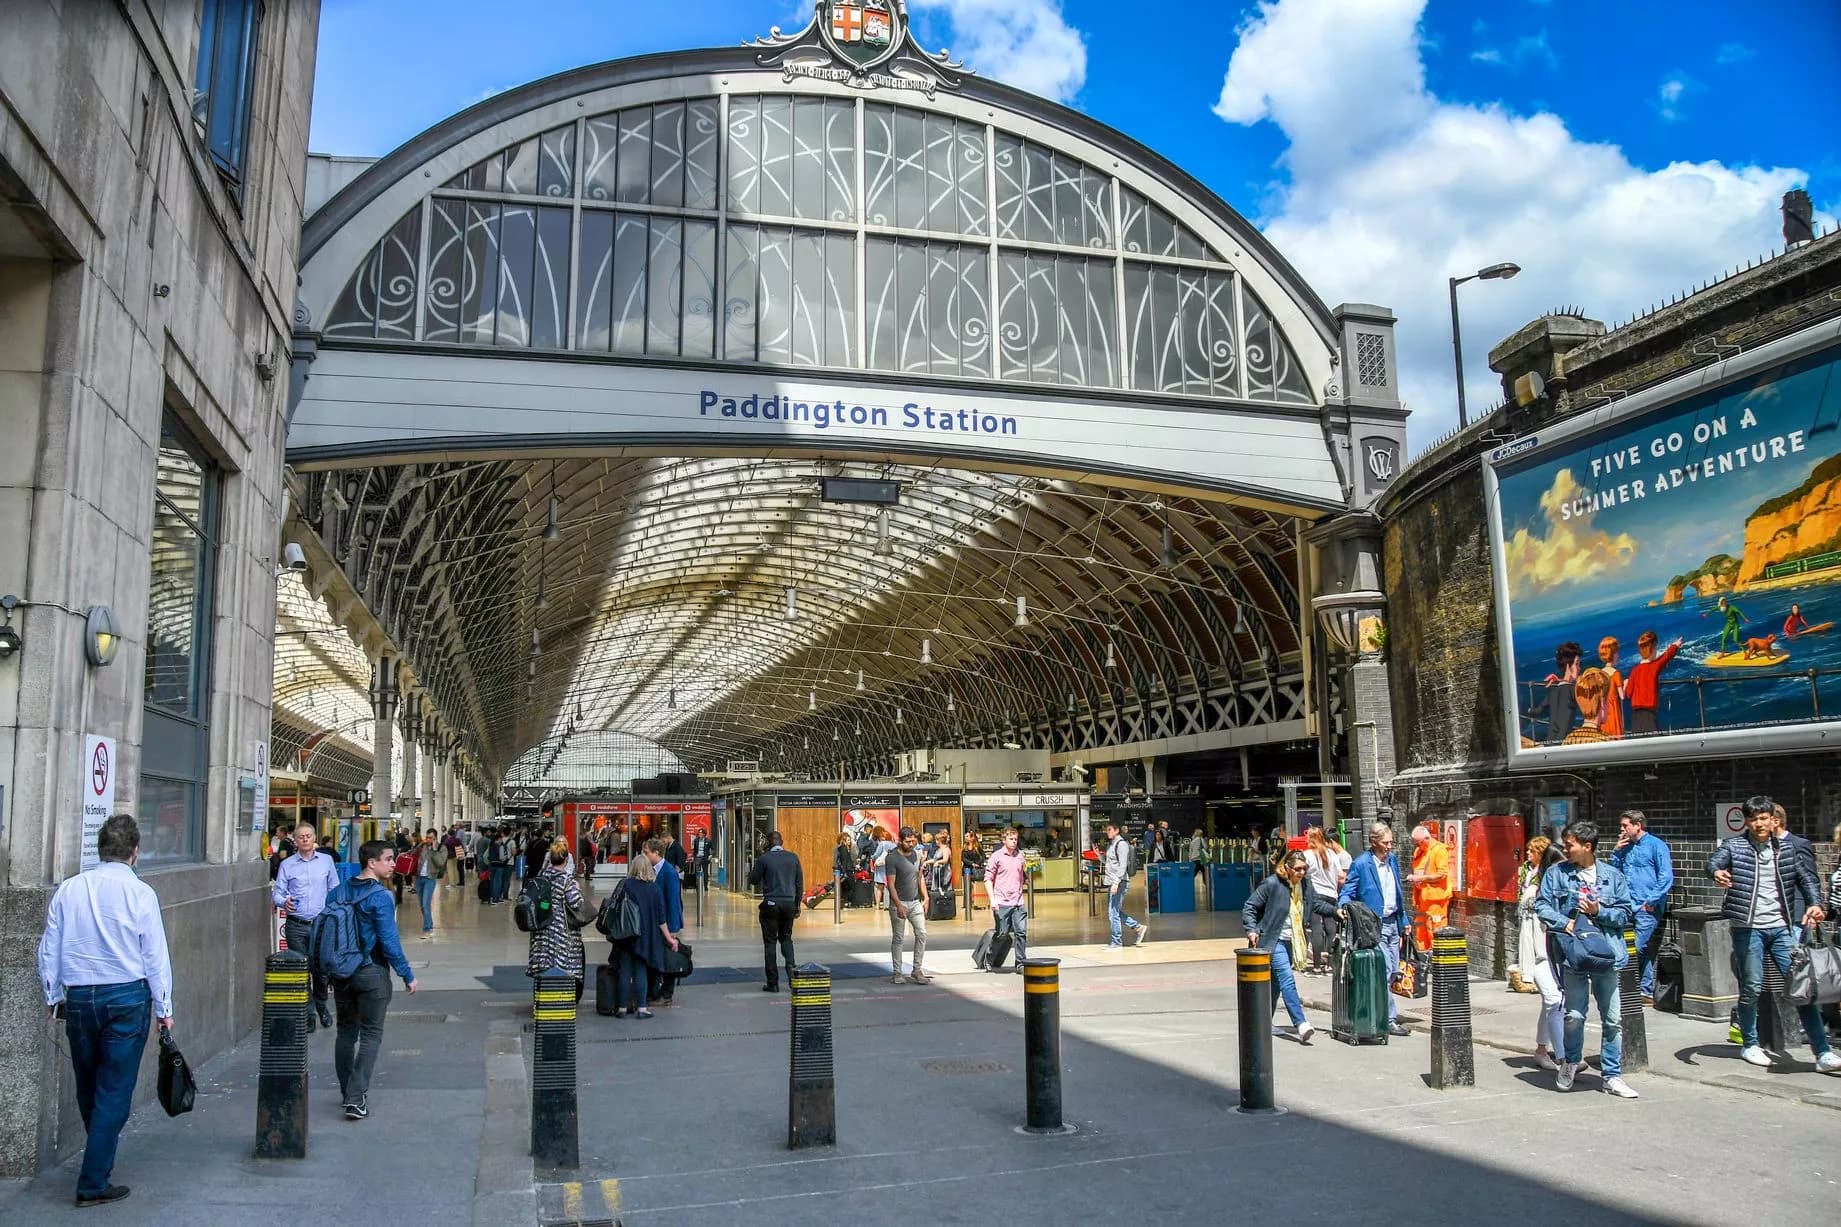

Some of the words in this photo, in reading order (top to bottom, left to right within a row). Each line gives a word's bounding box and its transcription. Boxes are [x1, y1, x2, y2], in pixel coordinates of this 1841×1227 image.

[700, 390, 887, 429] Paddington
[902, 403, 1017, 434] Station
[1592, 445, 1641, 478] FIVE
[1651, 432, 1683, 458] GO
[1694, 416, 1728, 443] ON
[1740, 407, 1758, 429] A
[1561, 479, 1646, 521] SUMMER
[1655, 430, 1806, 493] ADVENTURE
[91, 804, 106, 818] Smoking
